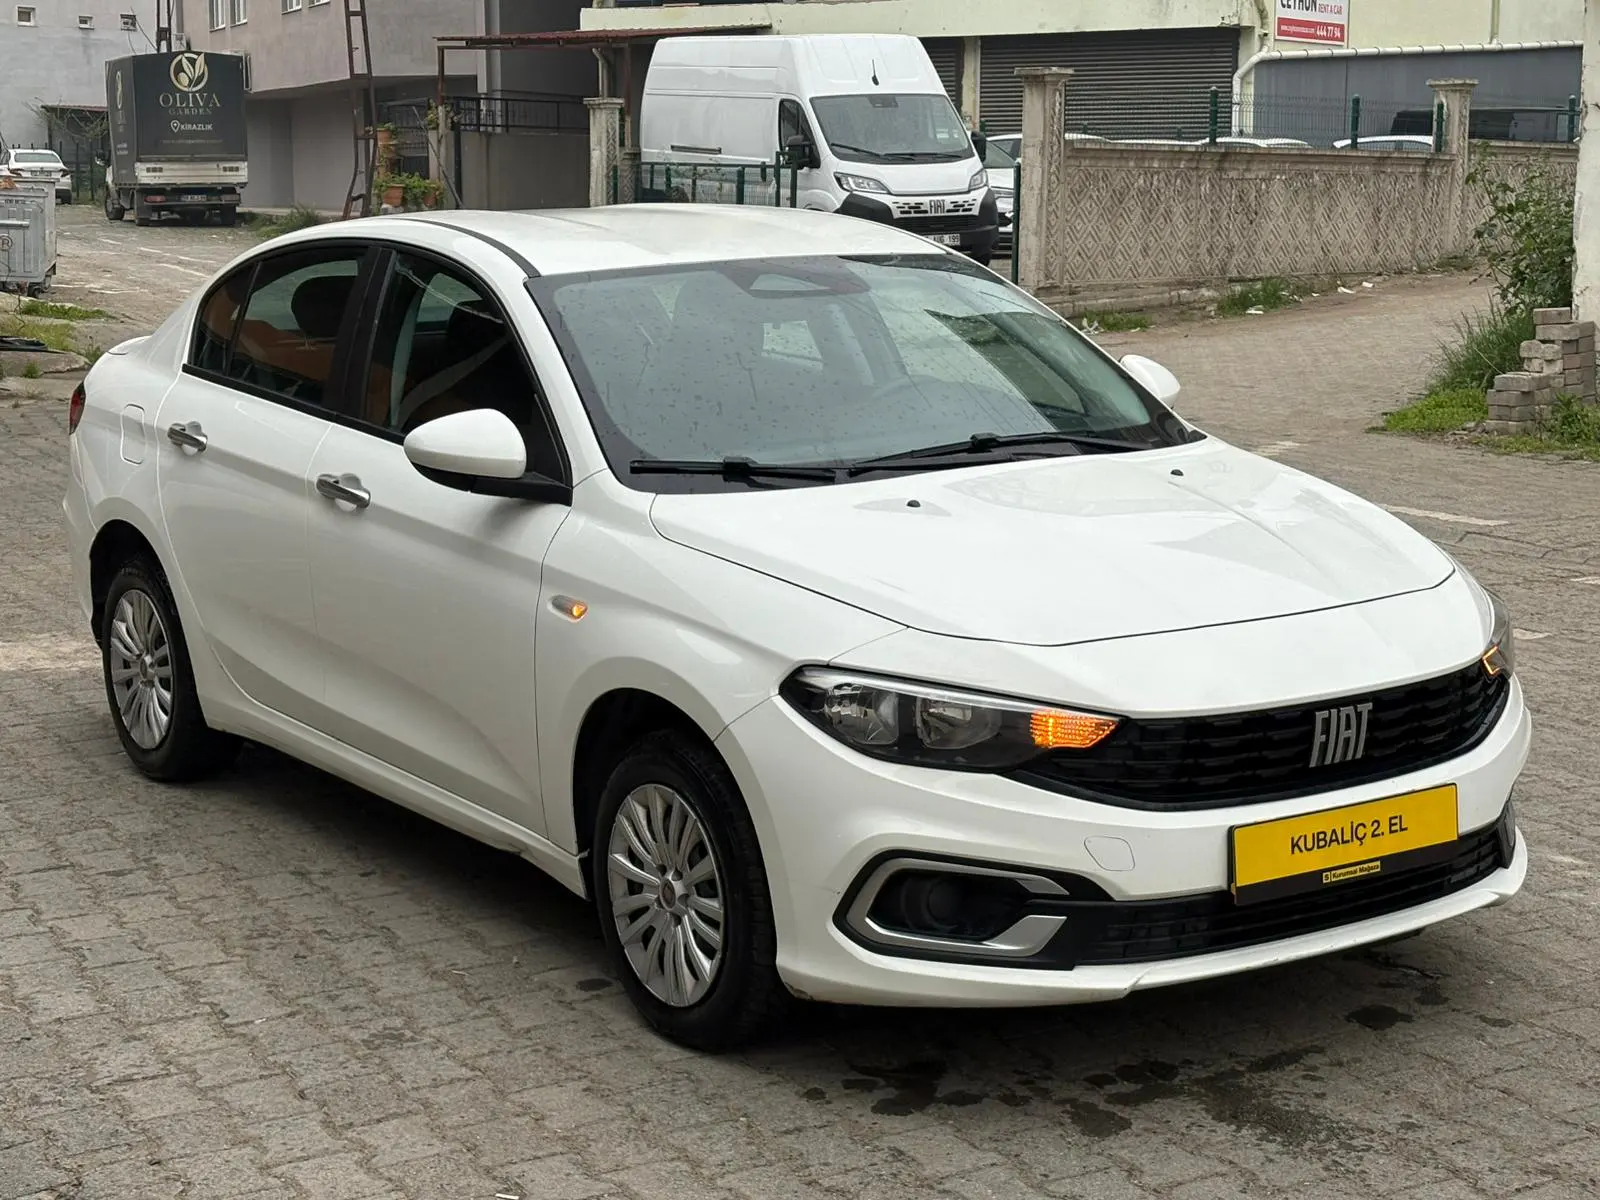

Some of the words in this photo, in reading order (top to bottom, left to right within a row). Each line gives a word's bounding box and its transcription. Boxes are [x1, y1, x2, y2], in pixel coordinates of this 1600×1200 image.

[1316, 25, 1327, 37] 444
[1327, 26, 1334, 37] 77
[159, 92, 221, 107] OLIVA
[168, 107, 213, 116] GARDEN
[180, 122, 213, 131] KİRAZLIK
[929, 199, 946, 214] FIAT
[1309, 702, 1373, 768] FIAT
[1290, 821, 1367, 855] KUBALİÇ
[1371, 819, 1385, 838] 2.
[1388, 815, 1408, 833] EL
[1332, 868, 1358, 879] Kurumsal
[1358, 863, 1380, 873] Mağaza
